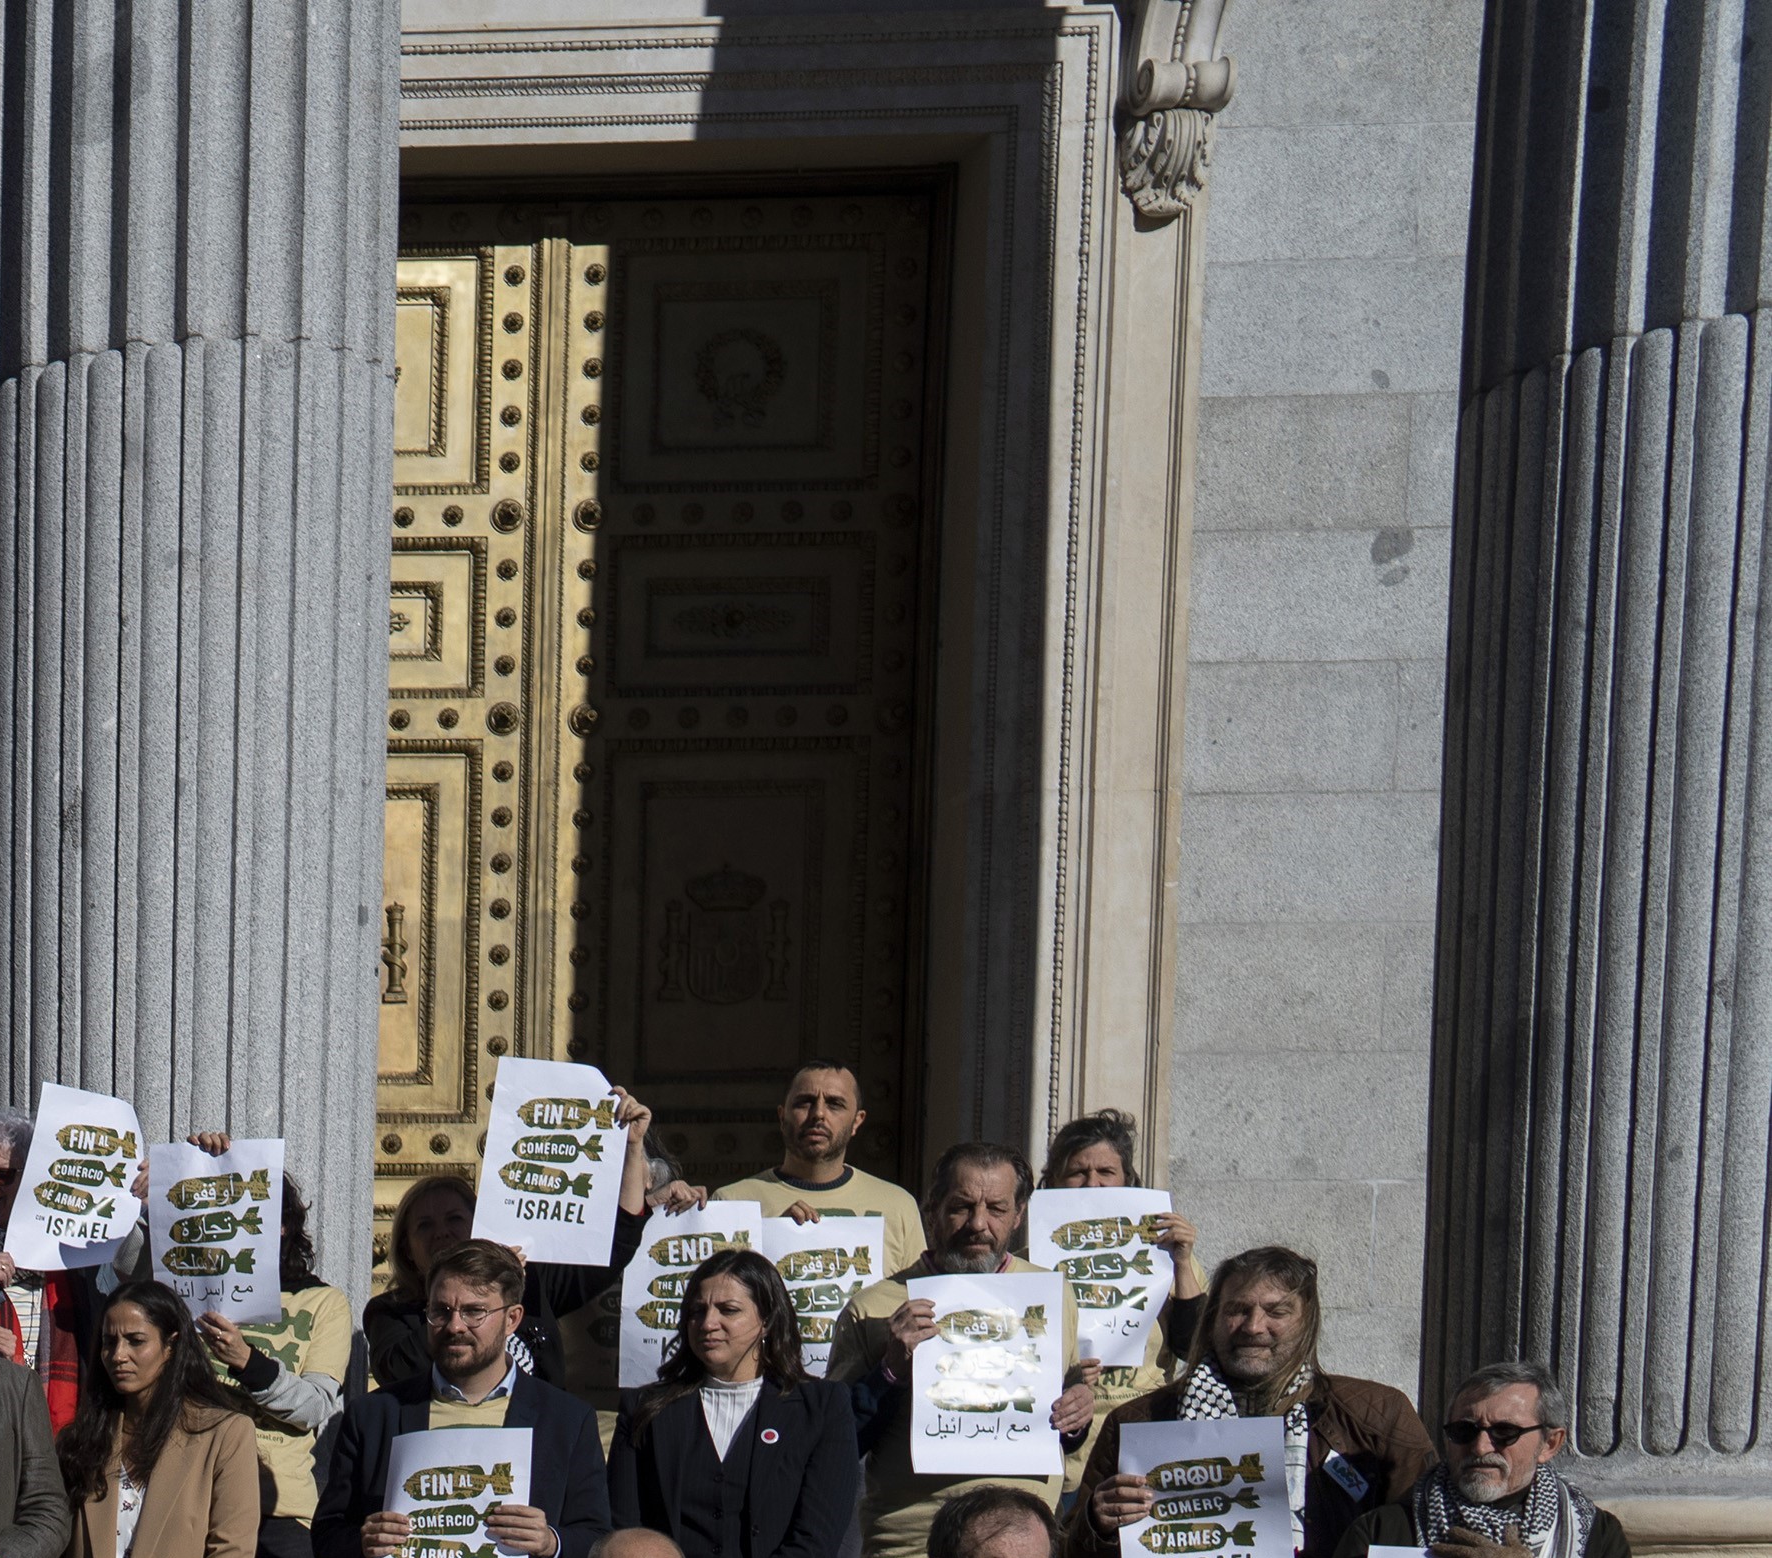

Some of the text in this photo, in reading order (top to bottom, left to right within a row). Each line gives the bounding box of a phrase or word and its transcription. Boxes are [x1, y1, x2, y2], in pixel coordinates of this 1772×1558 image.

[532, 1103, 564, 1126] FIN
[69, 1129, 94, 1150] FIN
[519, 1140, 577, 1159] COMERCIO
[54, 1164, 104, 1181] COMERCIO
[524, 1172, 562, 1191] ARMAS
[55, 1192, 88, 1210] ARMAS
[515, 1197, 586, 1225] ISRAEL
[45, 1215, 110, 1240] ISRAEL
[181, 1215, 233, 1241] تجارة
[667, 1236, 713, 1262] END
[1068, 1255, 1121, 1278] تجارة
[925, 1414, 1030, 1441] مع إسرائيل
[420, 1473, 454, 1496] FIN
[1157, 1496, 1223, 1517] COMERÇ
[409, 1514, 475, 1530] COMERCIO
[1151, 1529, 1221, 1549] D'ARMES
